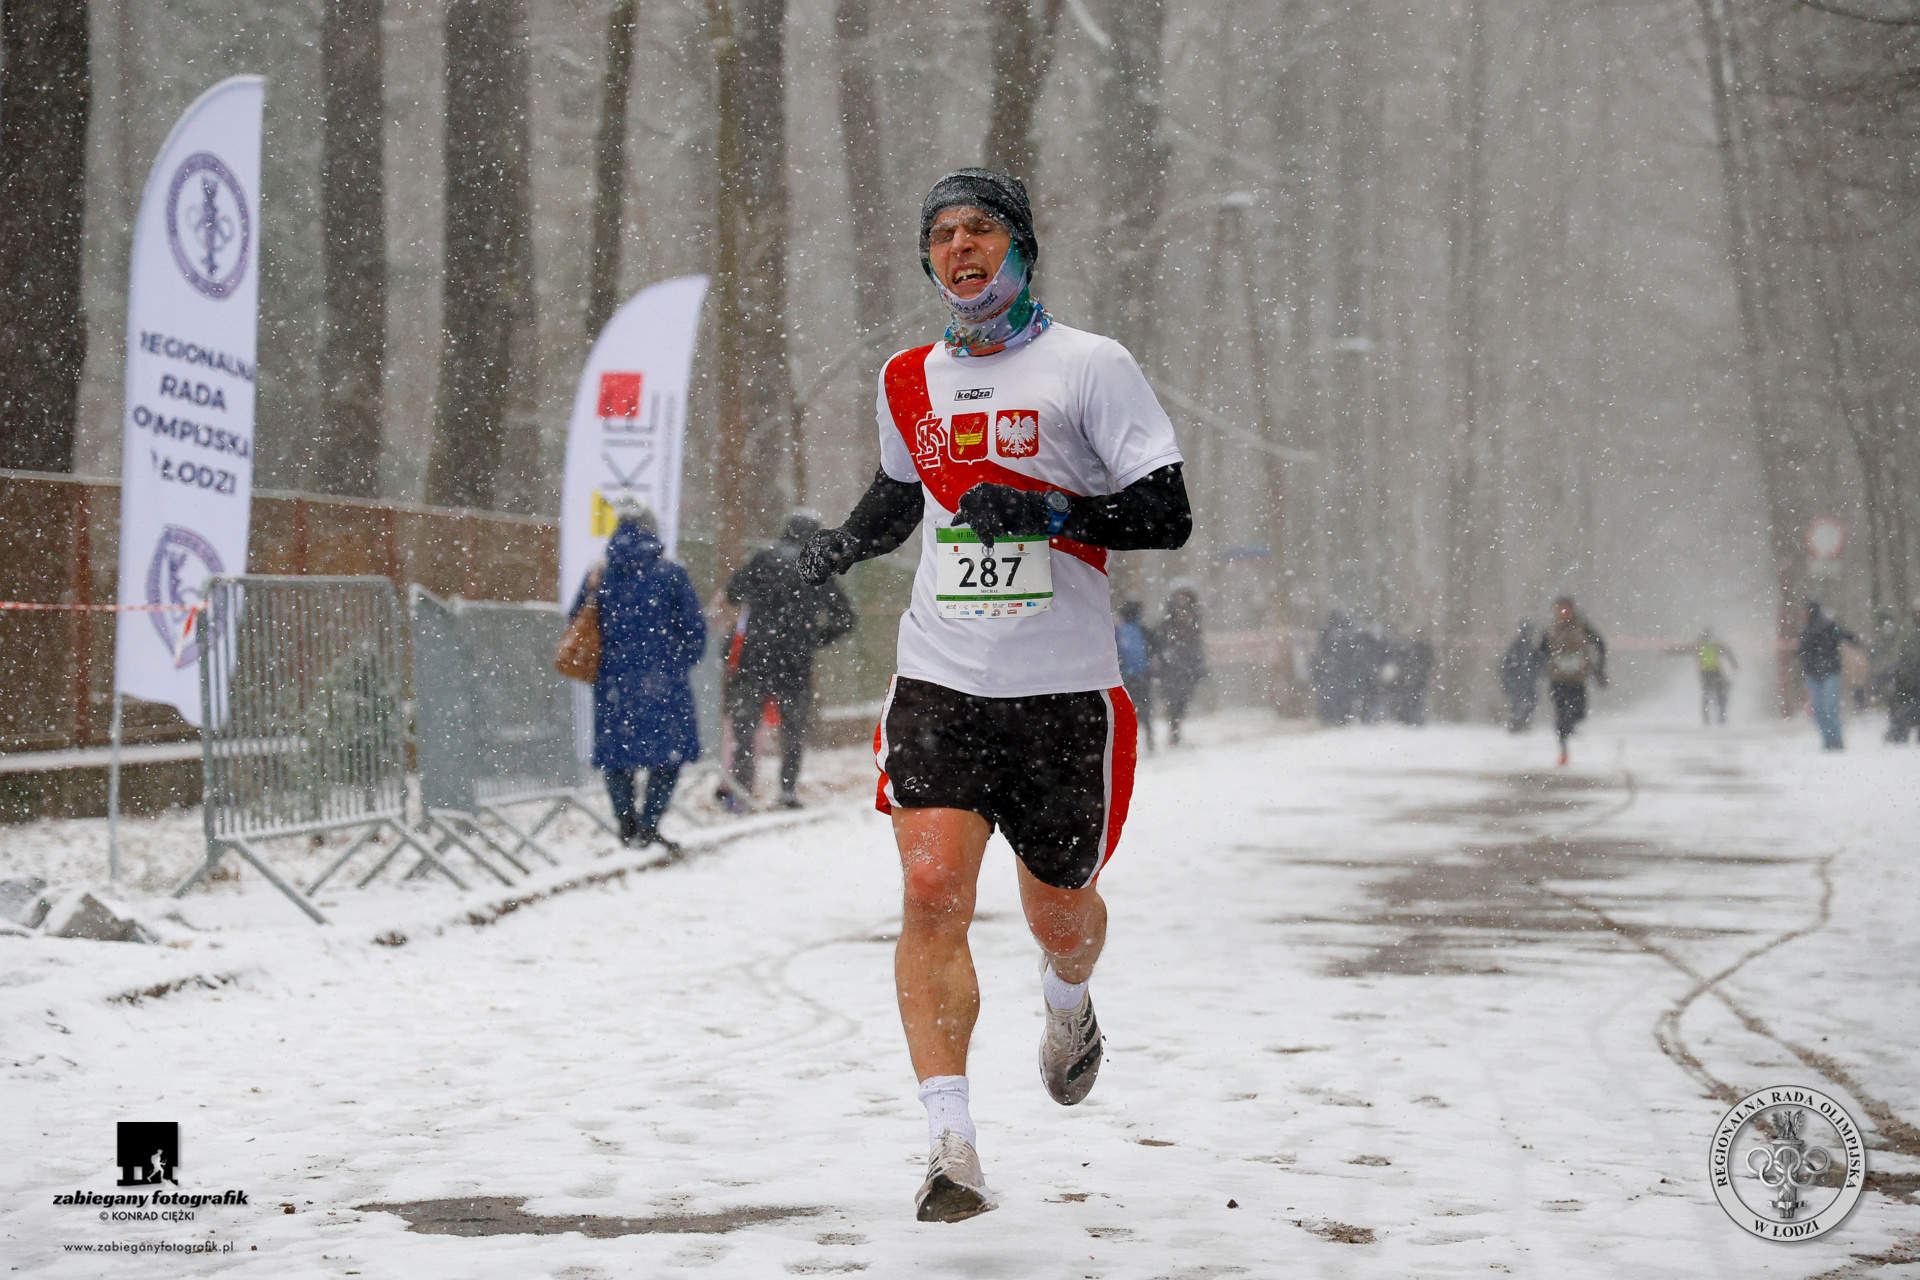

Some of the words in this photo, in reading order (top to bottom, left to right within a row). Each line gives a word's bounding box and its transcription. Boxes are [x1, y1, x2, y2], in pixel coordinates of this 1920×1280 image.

[160, 374, 226, 412] RADA
[161, 456, 237, 495] ŁODZI
[958, 557, 1022, 588] 287
